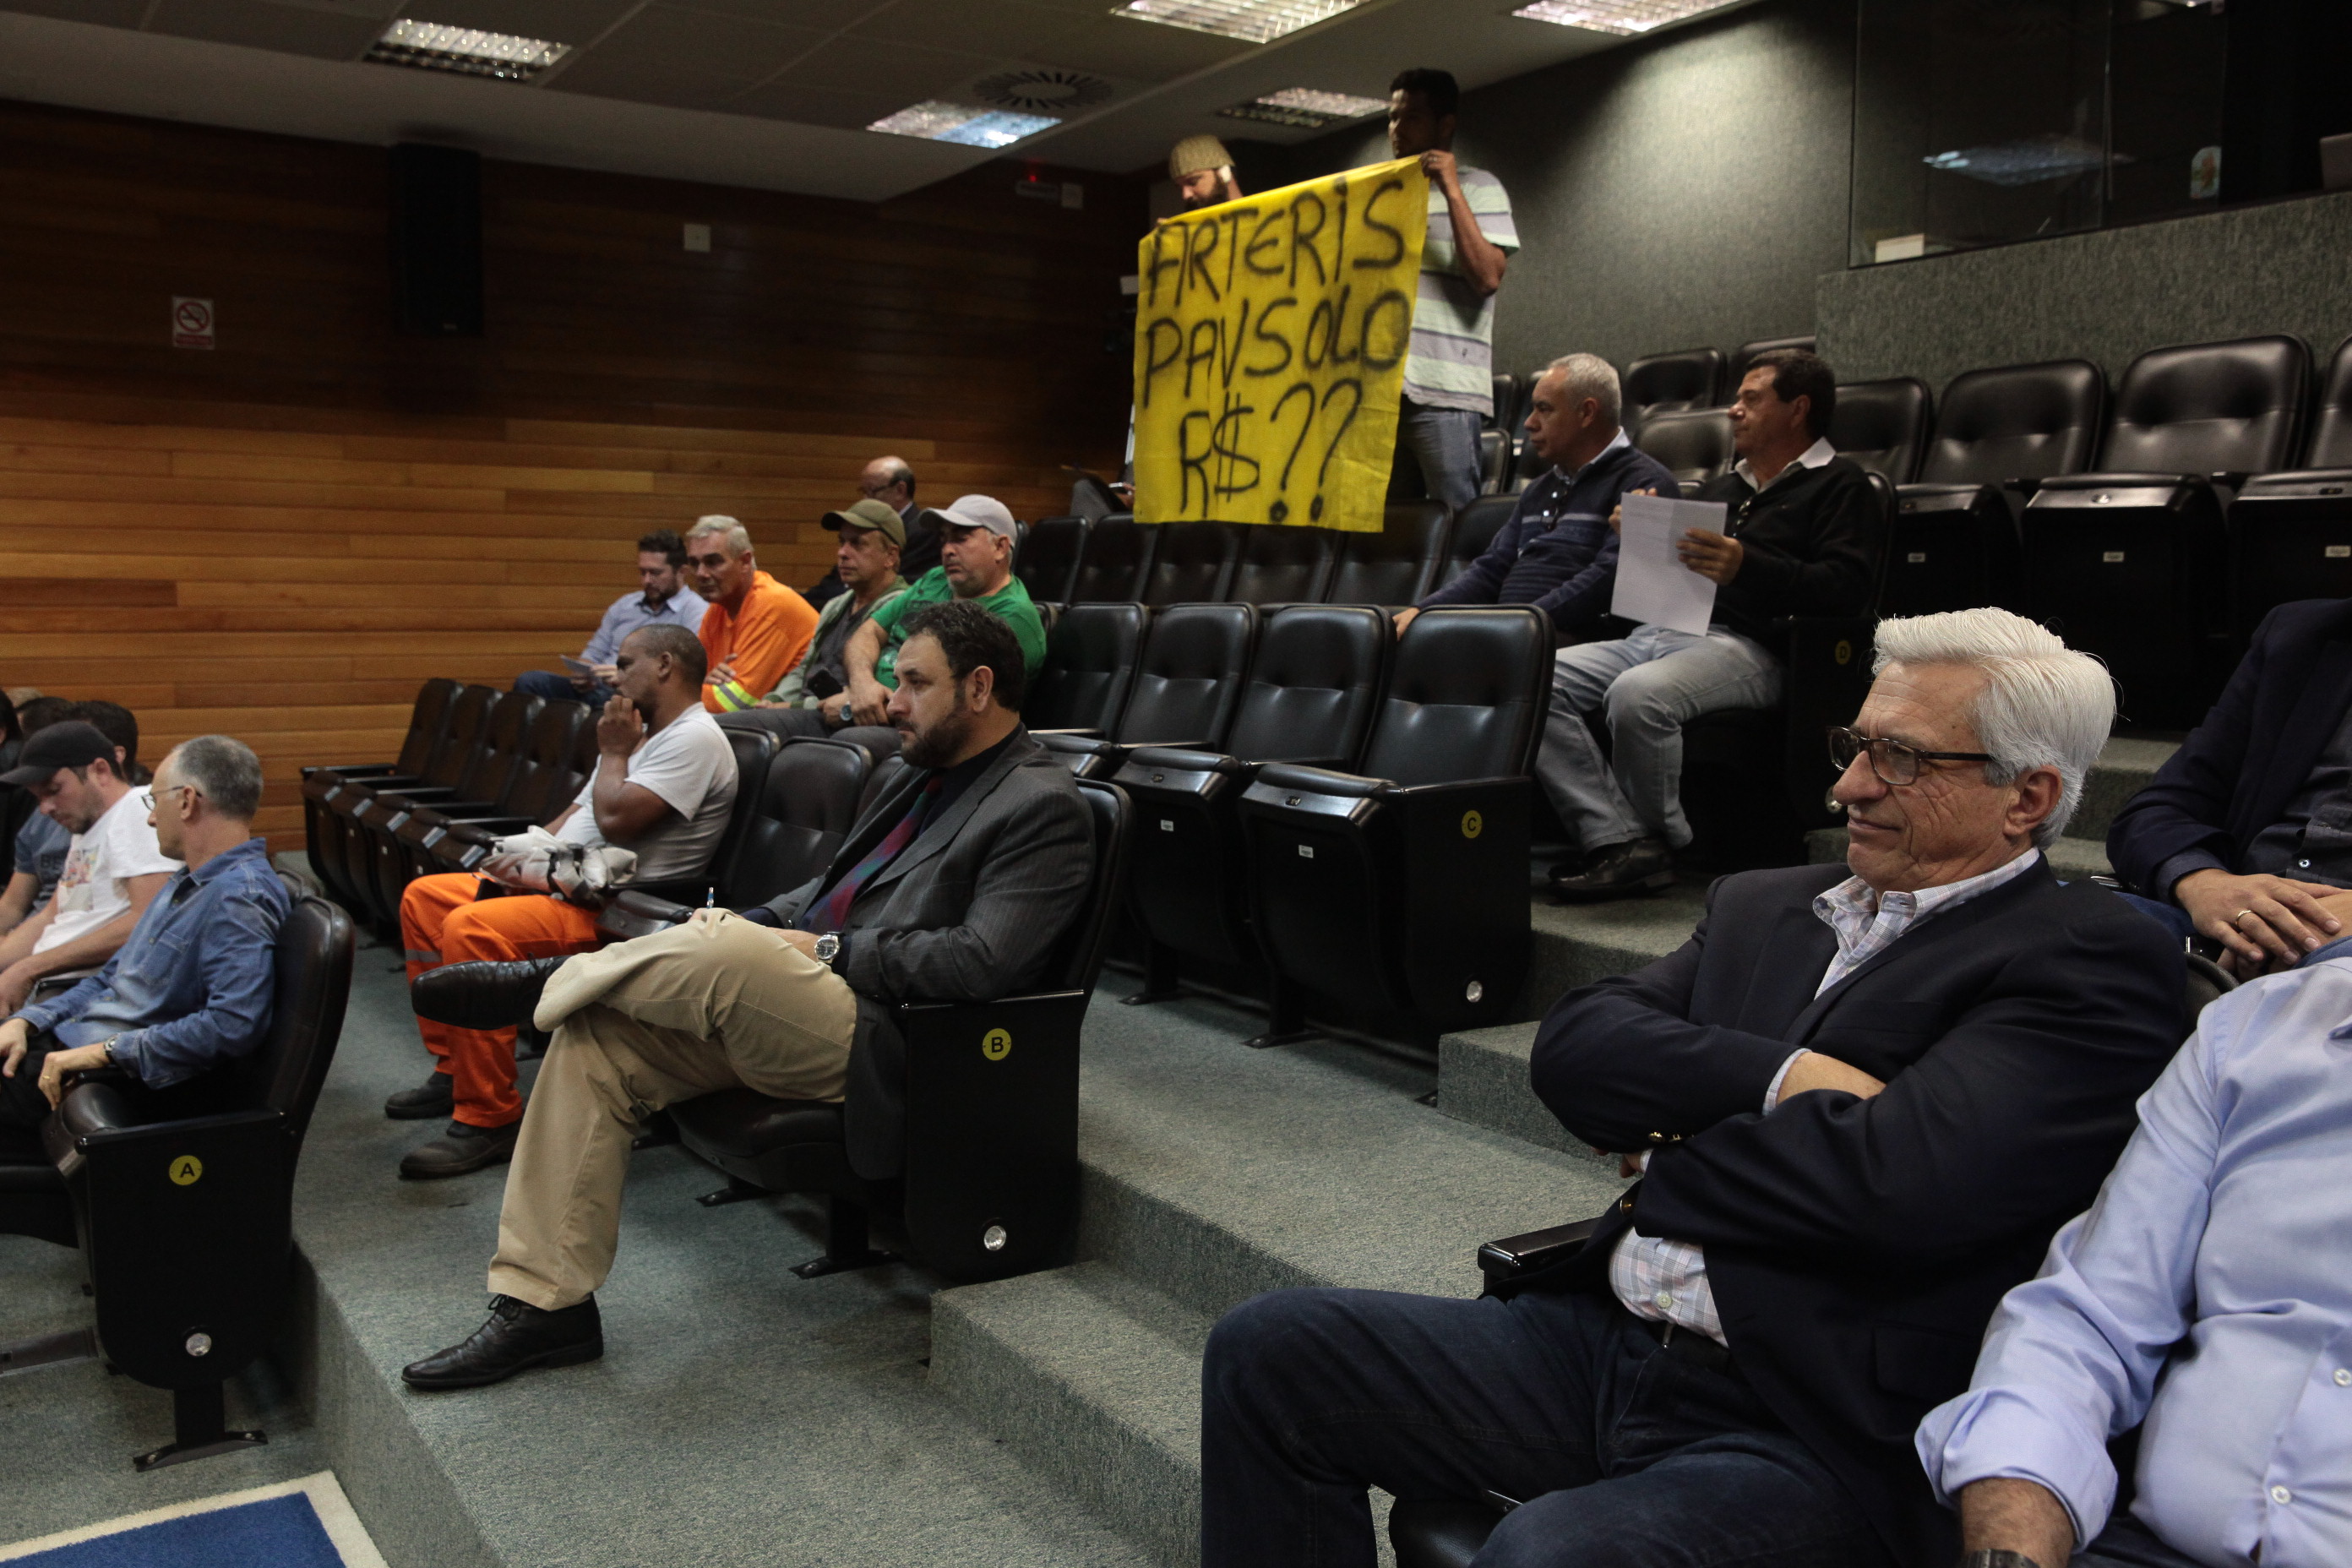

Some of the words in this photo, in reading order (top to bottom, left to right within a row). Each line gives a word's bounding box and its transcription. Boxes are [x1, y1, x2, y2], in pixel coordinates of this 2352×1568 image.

[1467, 817, 1477, 831] C
[991, 1037, 1004, 1053] B
[179, 1162, 195, 1178] A
